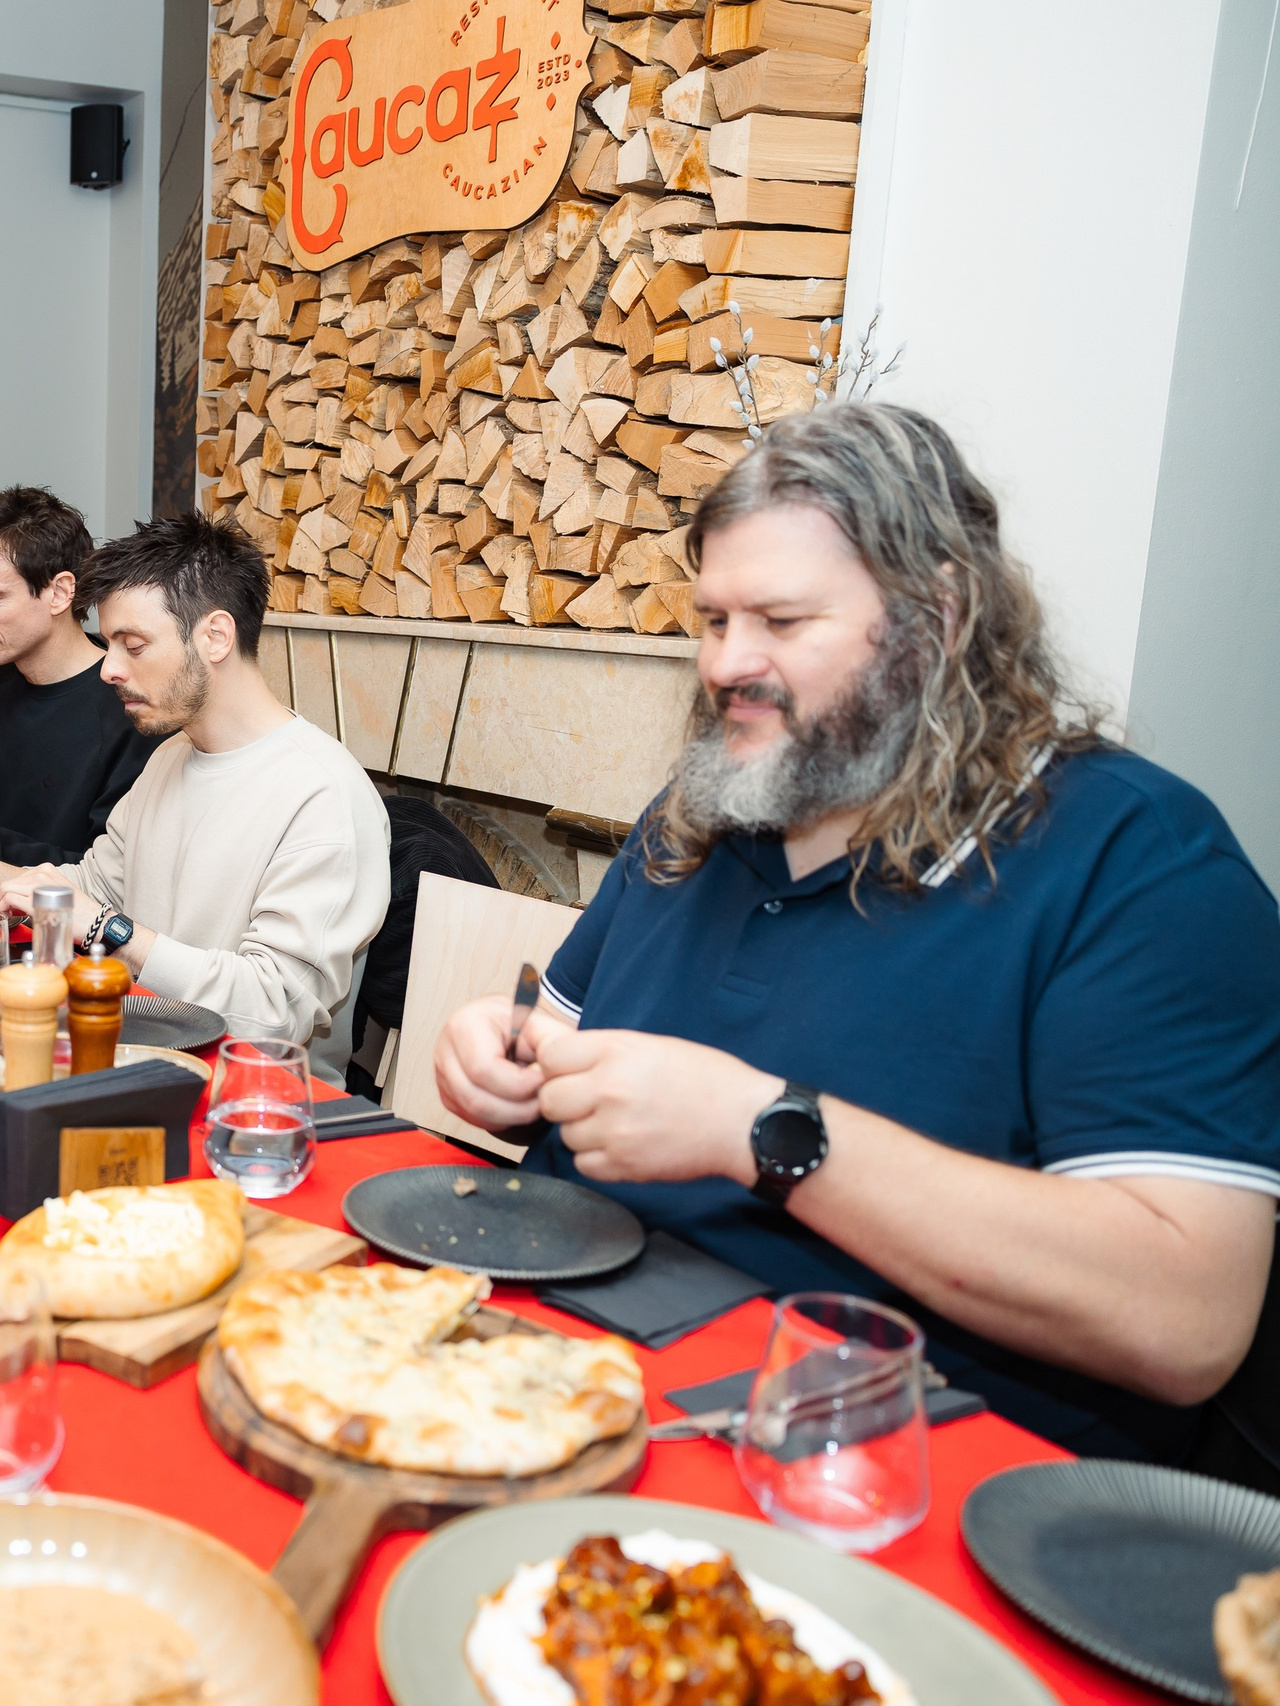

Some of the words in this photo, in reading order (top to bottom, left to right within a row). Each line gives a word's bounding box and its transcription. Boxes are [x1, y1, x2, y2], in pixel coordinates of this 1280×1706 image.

[536, 70, 570, 90] 2023
[537, 53, 571, 74] ESTD
[291, 16, 521, 254] Caucaz
[443, 136, 548, 200] CAUCAZIAN
